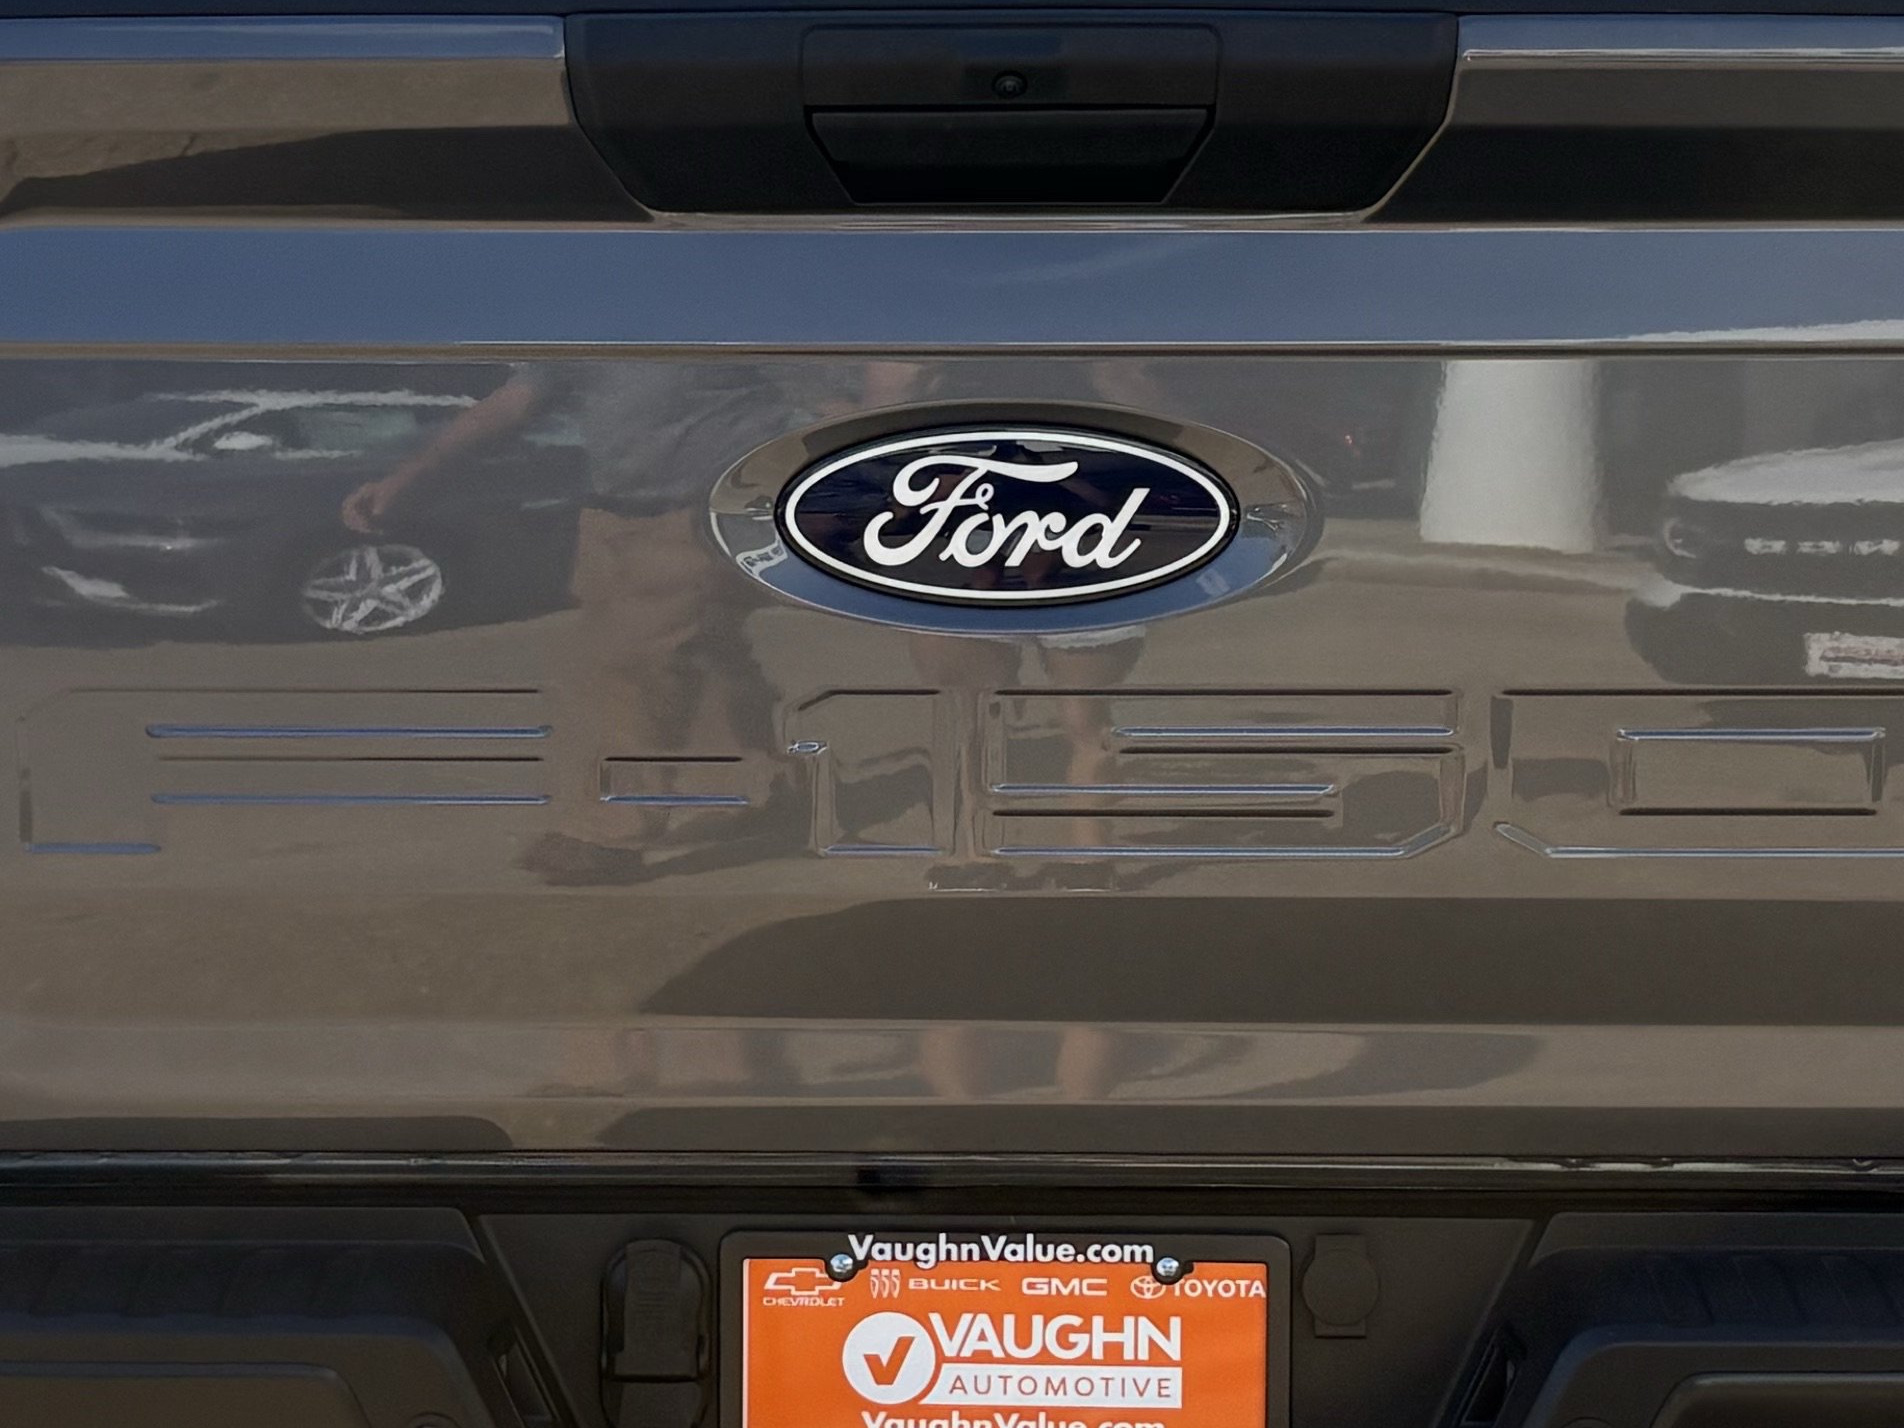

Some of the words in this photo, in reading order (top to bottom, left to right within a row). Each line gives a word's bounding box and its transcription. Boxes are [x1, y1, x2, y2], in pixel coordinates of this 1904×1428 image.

[863, 455, 1150, 568] Ford
[848, 1233, 1154, 1270] VaughnValue.com
[908, 1277, 1002, 1291] BUICK
[1022, 1277, 1108, 1296] GMC
[1172, 1279, 1266, 1298] TOYOTA
[929, 1312, 1182, 1361] VAUGHN
[949, 1375, 1172, 1400] AUTOMOTIVE
